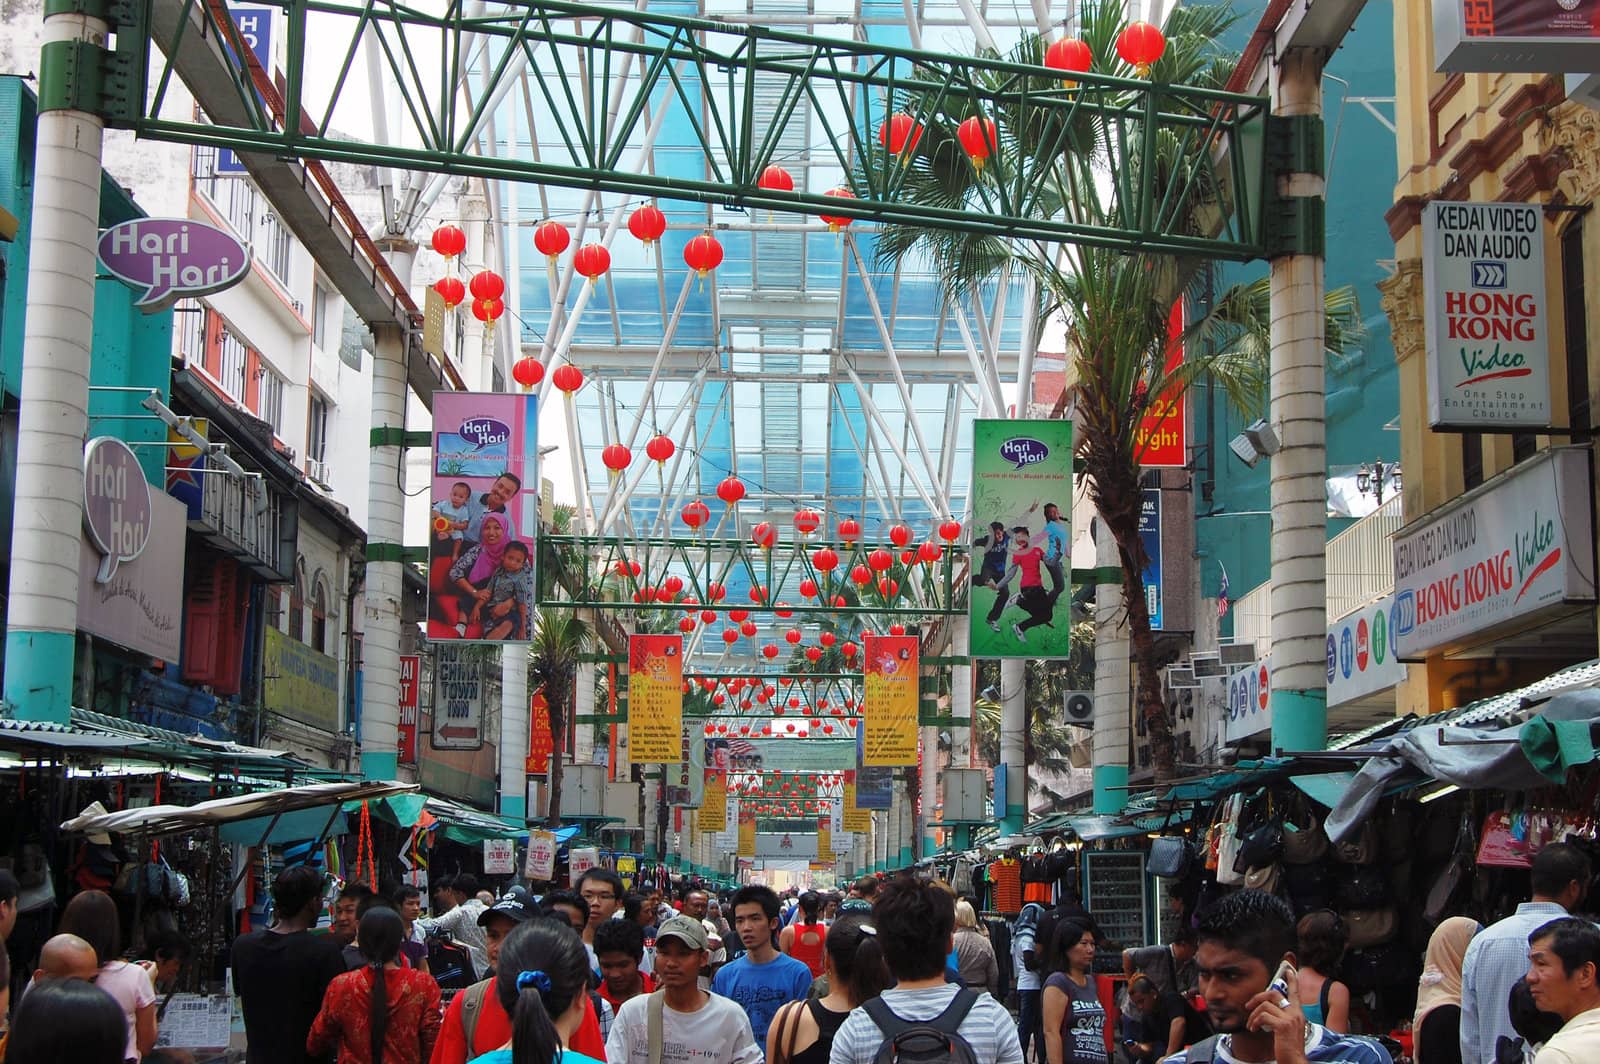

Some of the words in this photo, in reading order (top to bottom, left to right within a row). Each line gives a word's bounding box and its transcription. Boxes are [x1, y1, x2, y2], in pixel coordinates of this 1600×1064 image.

[1437, 206, 1485, 231] KEDAI
[1489, 207, 1537, 233] VIDEO
[112, 223, 189, 254] Hari
[1444, 233, 1477, 258] DAN
[1481, 235, 1531, 260] AUDIO
[152, 255, 229, 287] Hari
[1445, 291, 1537, 318] HONG
[1448, 316, 1536, 342] KONG
[1460, 343, 1525, 377] Video
[1444, 398, 1544, 410] Entertainment
[1464, 390, 1486, 399] One
[1496, 391, 1525, 401] Stop
[1472, 409, 1518, 419] Choice
[463, 421, 491, 434] Hari
[478, 432, 506, 445] Hari
[1004, 440, 1031, 454] Hari
[1018, 450, 1045, 463] Hari
[91, 445, 127, 500] Hari
[109, 503, 144, 555] Hari
[1417, 531, 1436, 571] VIDEO
[1438, 523, 1452, 561] DAN
[1453, 507, 1476, 553] AUDIO
[1416, 573, 1461, 625] HONG
[1463, 549, 1513, 607] KONG
[1516, 511, 1554, 583] Video
[439, 663, 479, 681] CHINA
[441, 681, 478, 700] TOWN
[447, 700, 470, 718] INN
